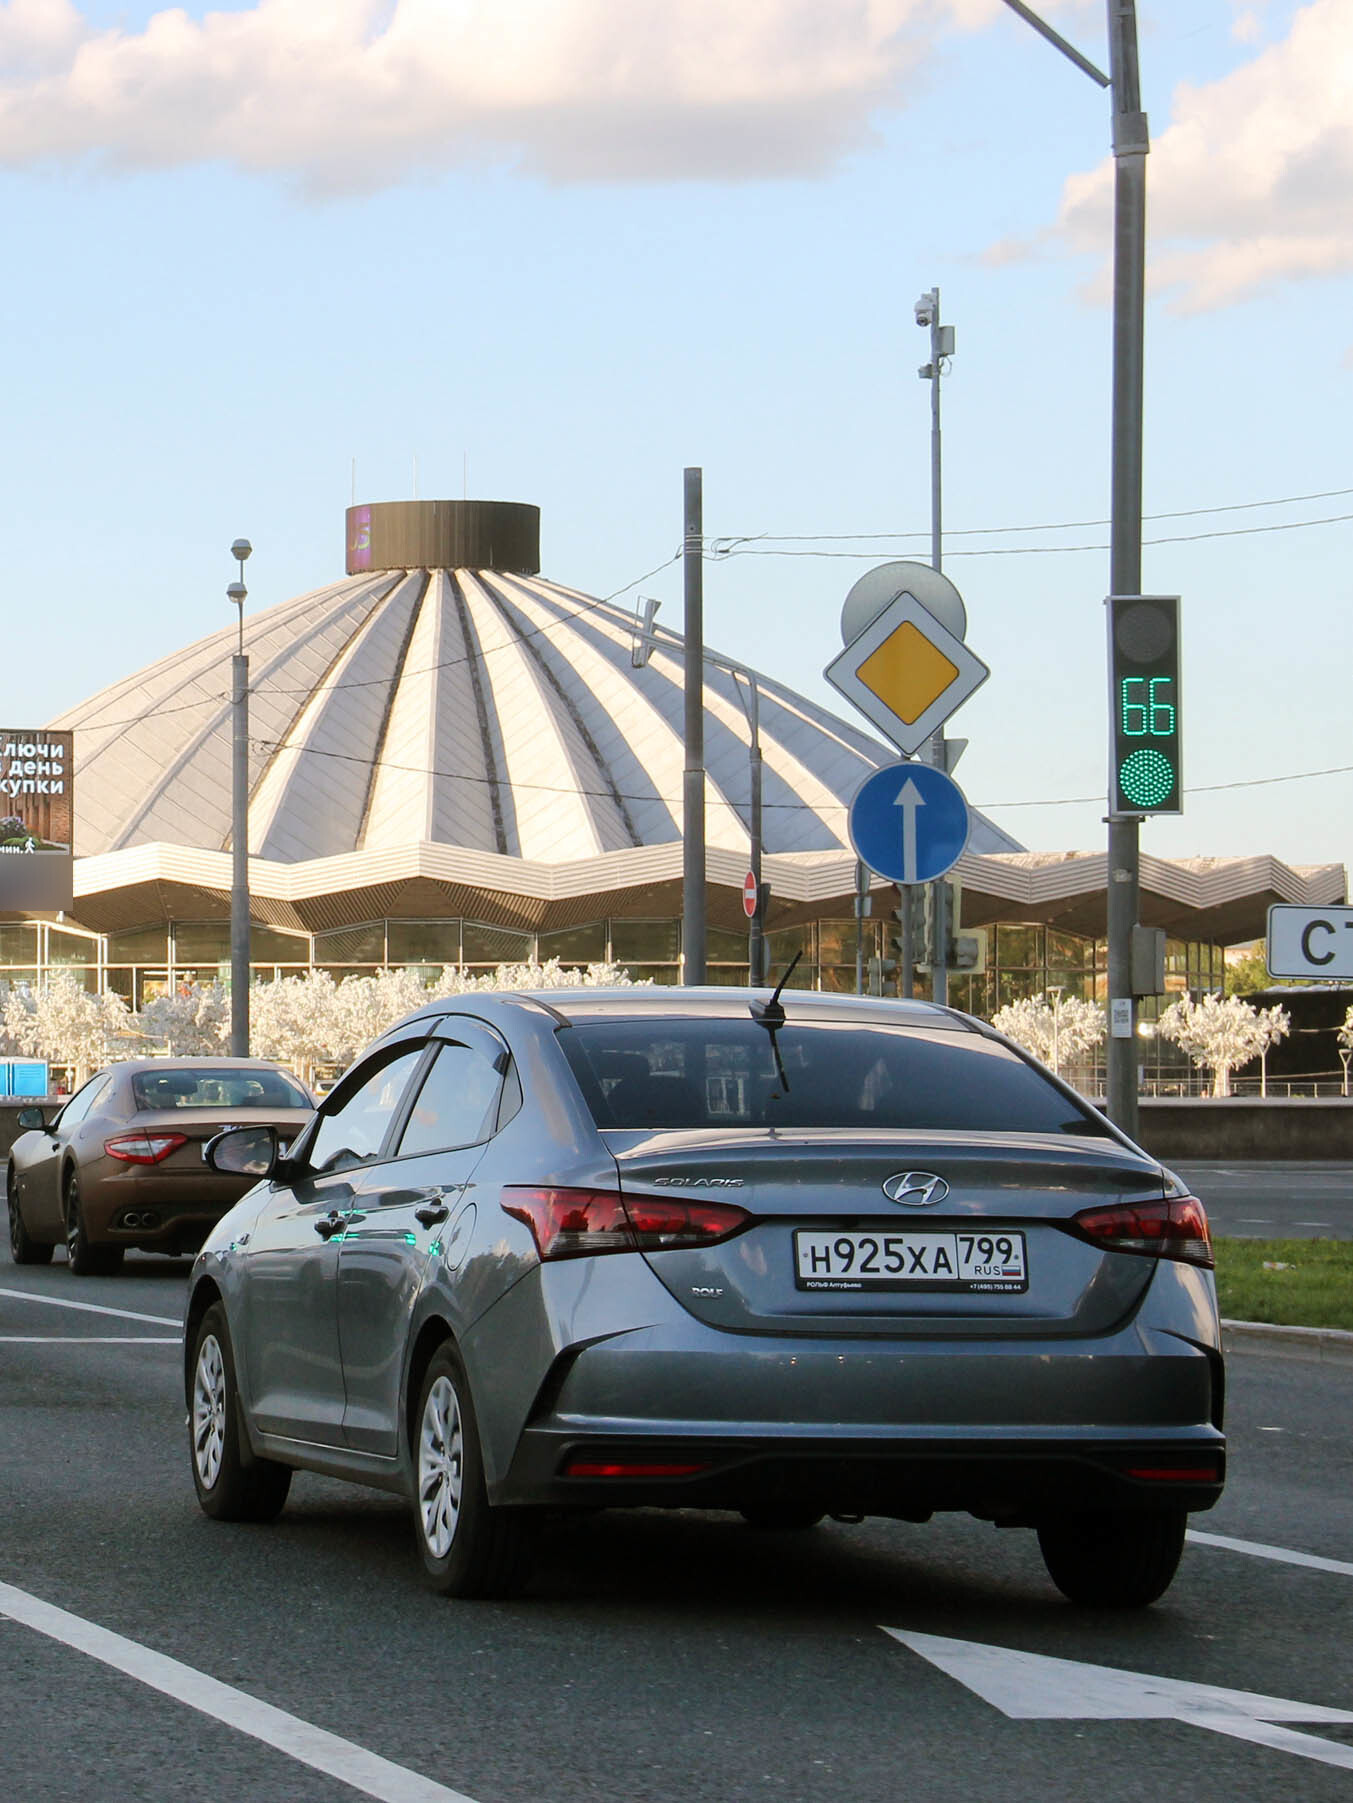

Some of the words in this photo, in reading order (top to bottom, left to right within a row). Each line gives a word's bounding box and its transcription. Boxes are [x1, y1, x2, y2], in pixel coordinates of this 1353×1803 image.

[1123, 678, 1175, 736] 66
[9, 761, 64, 776] день
[1301, 920, 1353, 967] С
[654, 1177, 745, 1188] SOLARIS
[810, 1238, 953, 1274] Н925ХА
[959, 1237, 1013, 1264] 799
[974, 1266, 1001, 1276] RUS
